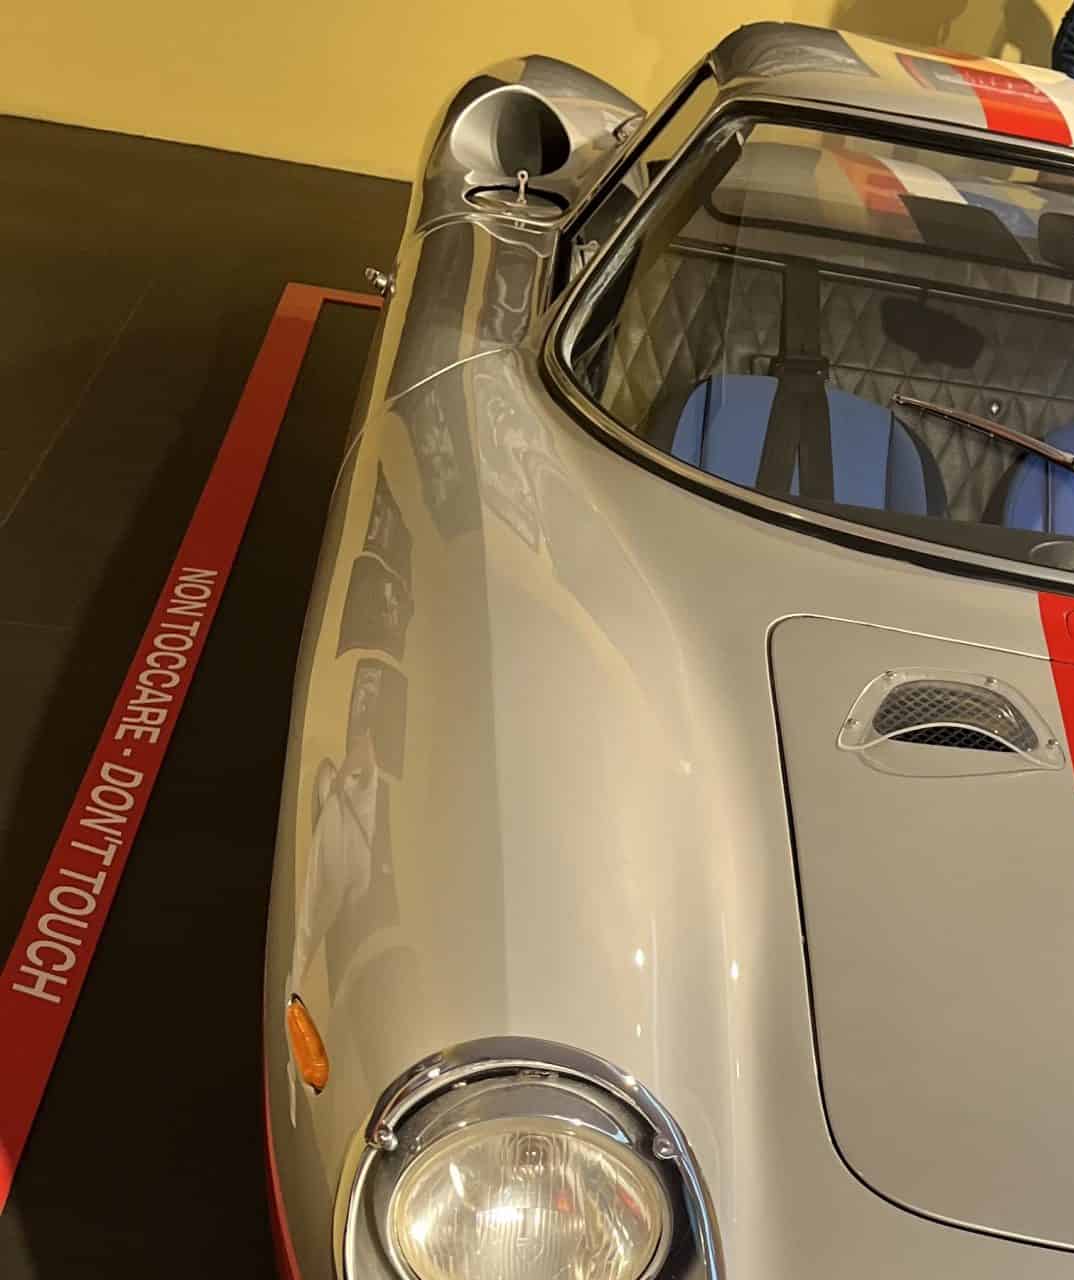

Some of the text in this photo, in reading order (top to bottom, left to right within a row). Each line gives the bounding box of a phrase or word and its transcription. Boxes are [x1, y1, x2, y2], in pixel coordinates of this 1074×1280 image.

[12, 566, 219, 1005] NON TOCCARE DON'T TOUCH
